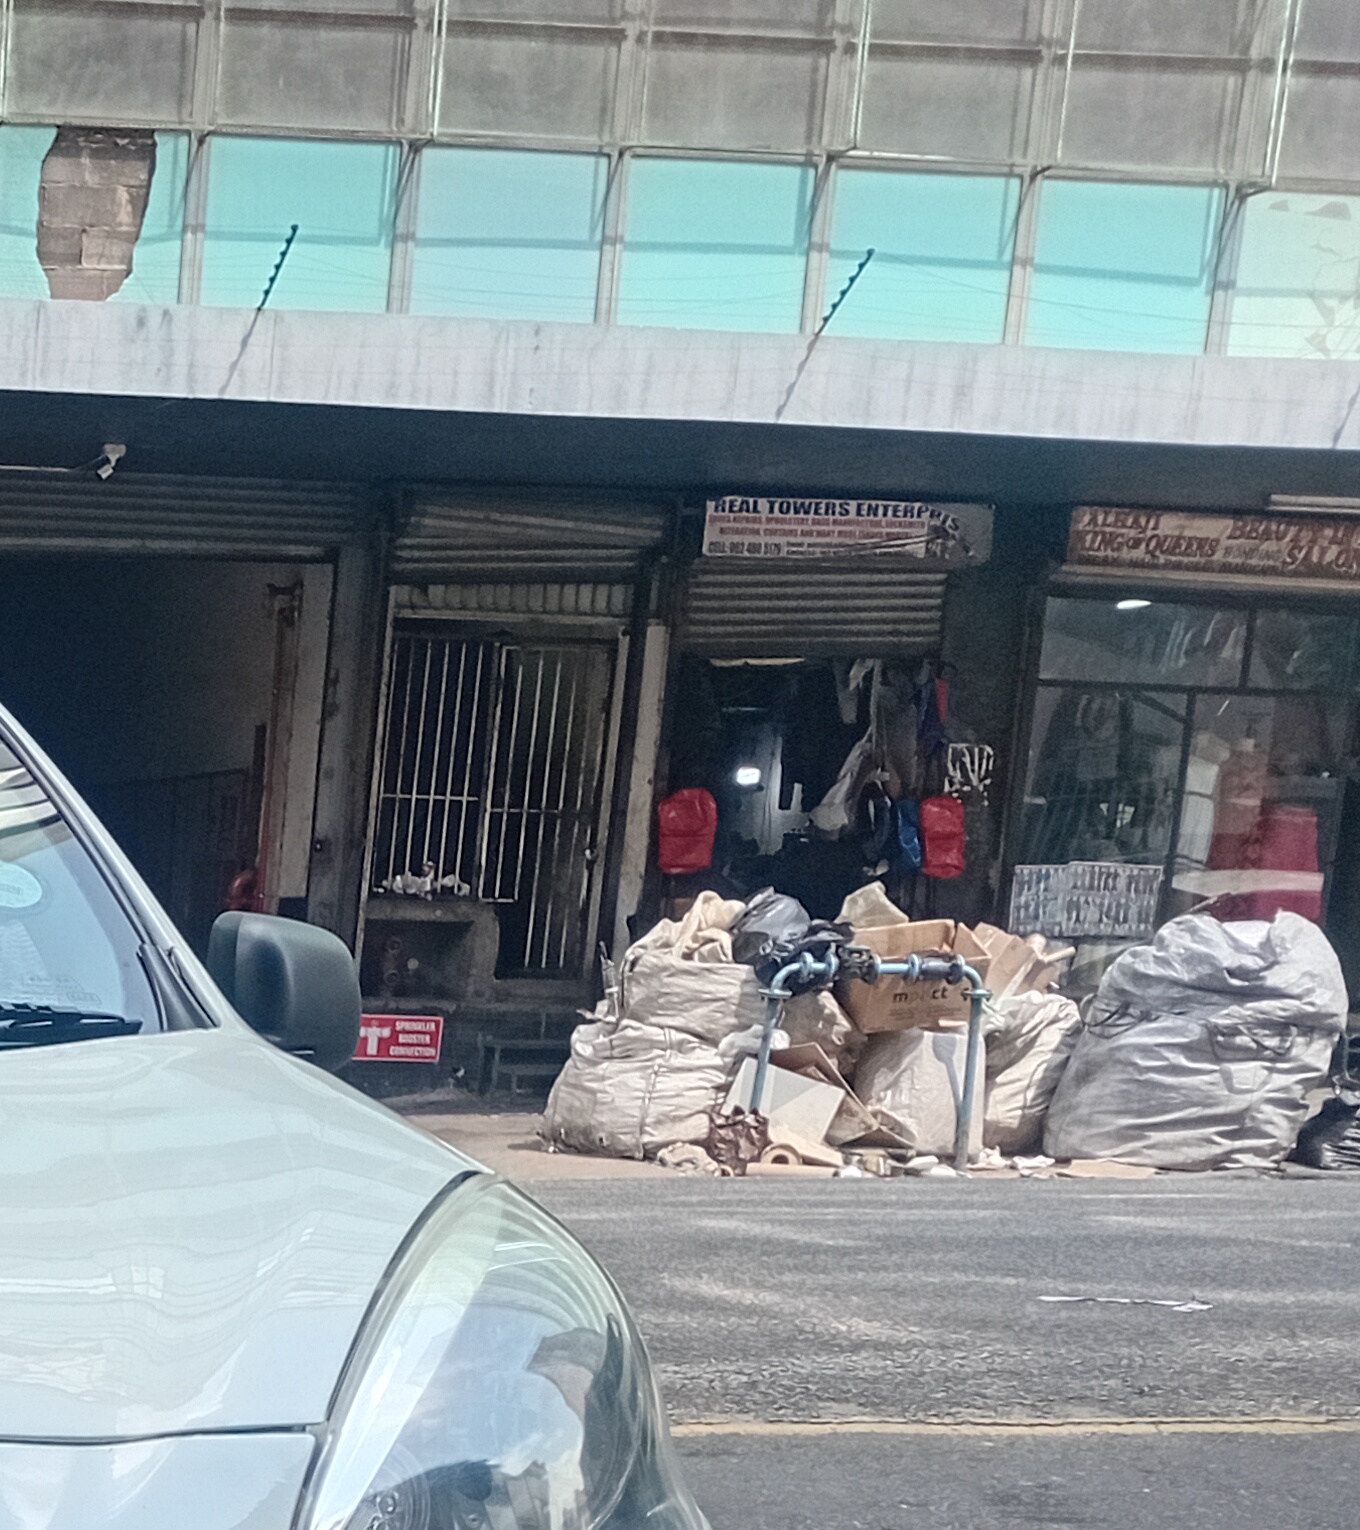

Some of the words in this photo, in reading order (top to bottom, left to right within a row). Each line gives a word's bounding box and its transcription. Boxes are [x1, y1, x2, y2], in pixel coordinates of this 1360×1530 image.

[714, 498, 763, 515] REAL
[766, 500, 851, 518] TOWERS
[1144, 533, 1222, 559] QUEENS
[395, 1020, 436, 1032] SPRINKLER
[398, 1033, 431, 1044] BOOSTER
[389, 1045, 437, 1057] CONNECTION
